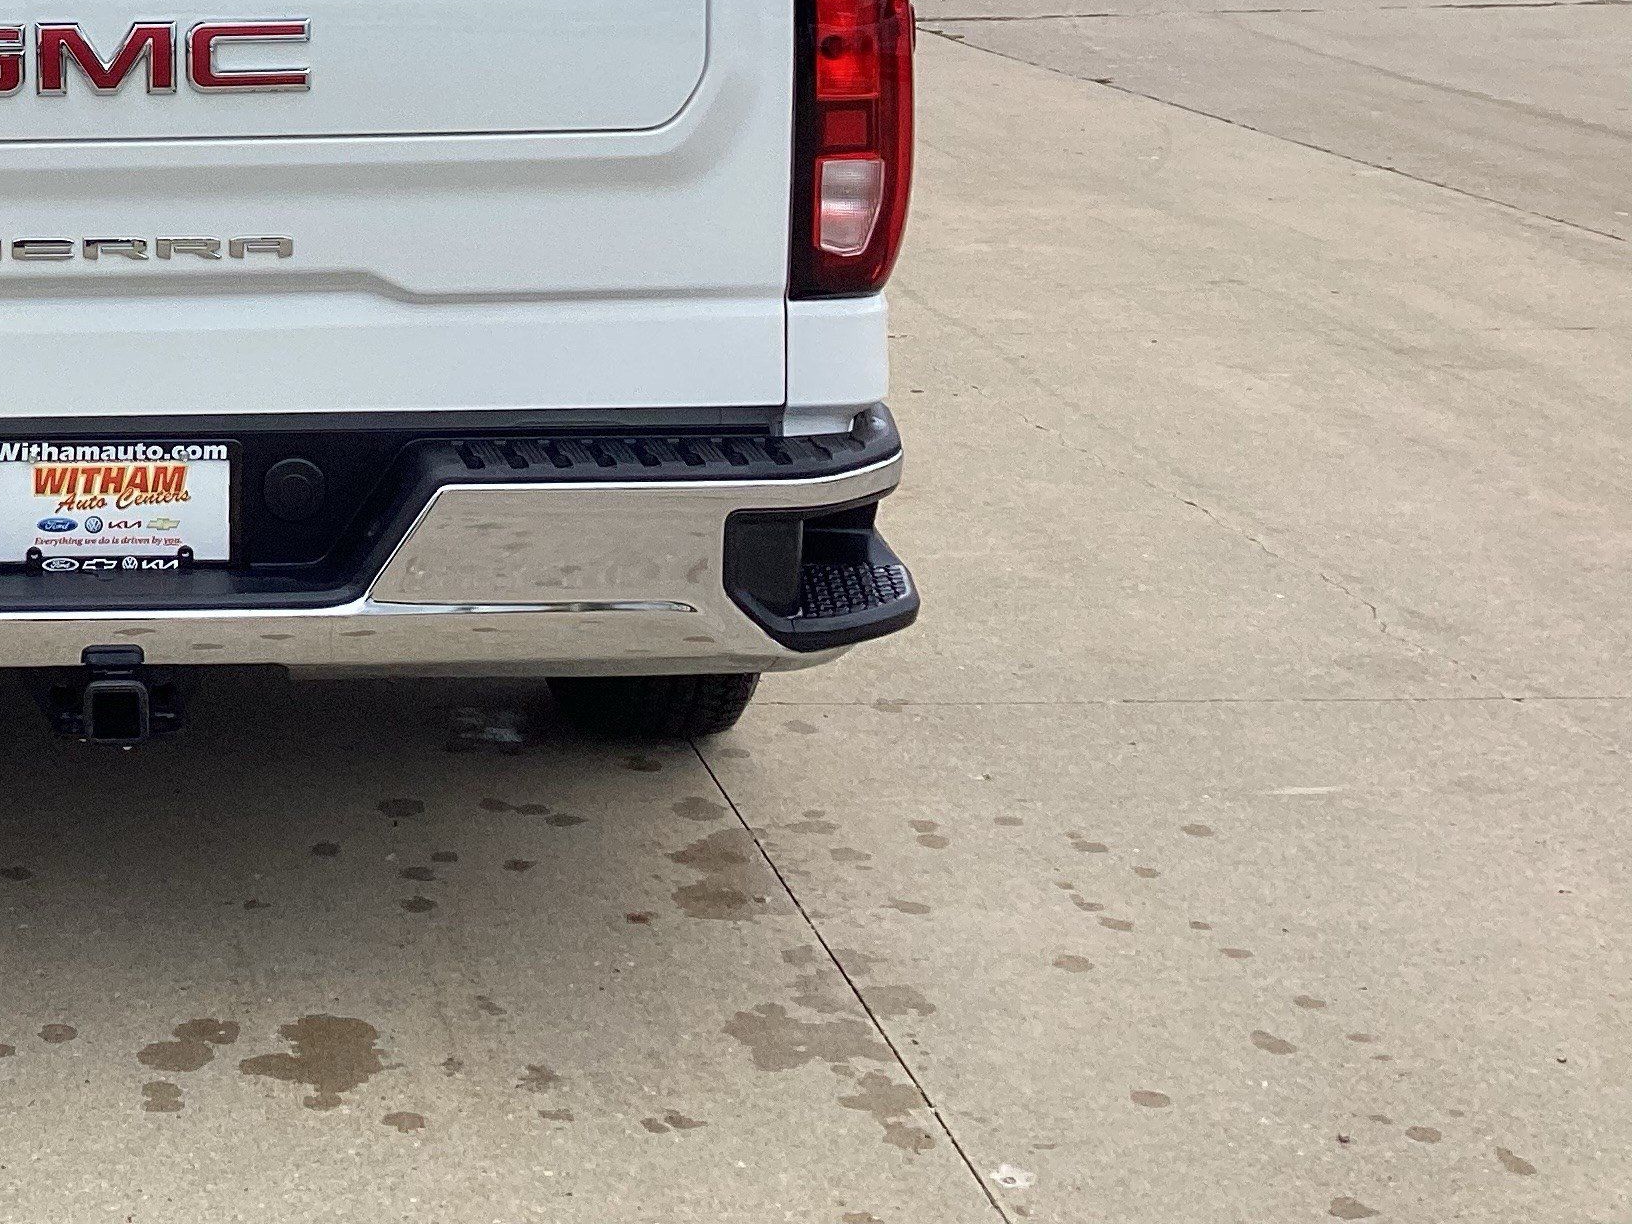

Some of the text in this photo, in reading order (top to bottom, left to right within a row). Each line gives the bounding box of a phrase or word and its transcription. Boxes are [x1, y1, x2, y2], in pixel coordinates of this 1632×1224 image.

[34, 465, 188, 496] WITHAM
[55, 487, 191, 514] Auto Centers
[35, 537, 84, 547] Everything
[99, 536, 111, 545] do
[112, 536, 120, 545] is
[121, 536, 150, 545] driven
[152, 536, 163, 547] by
